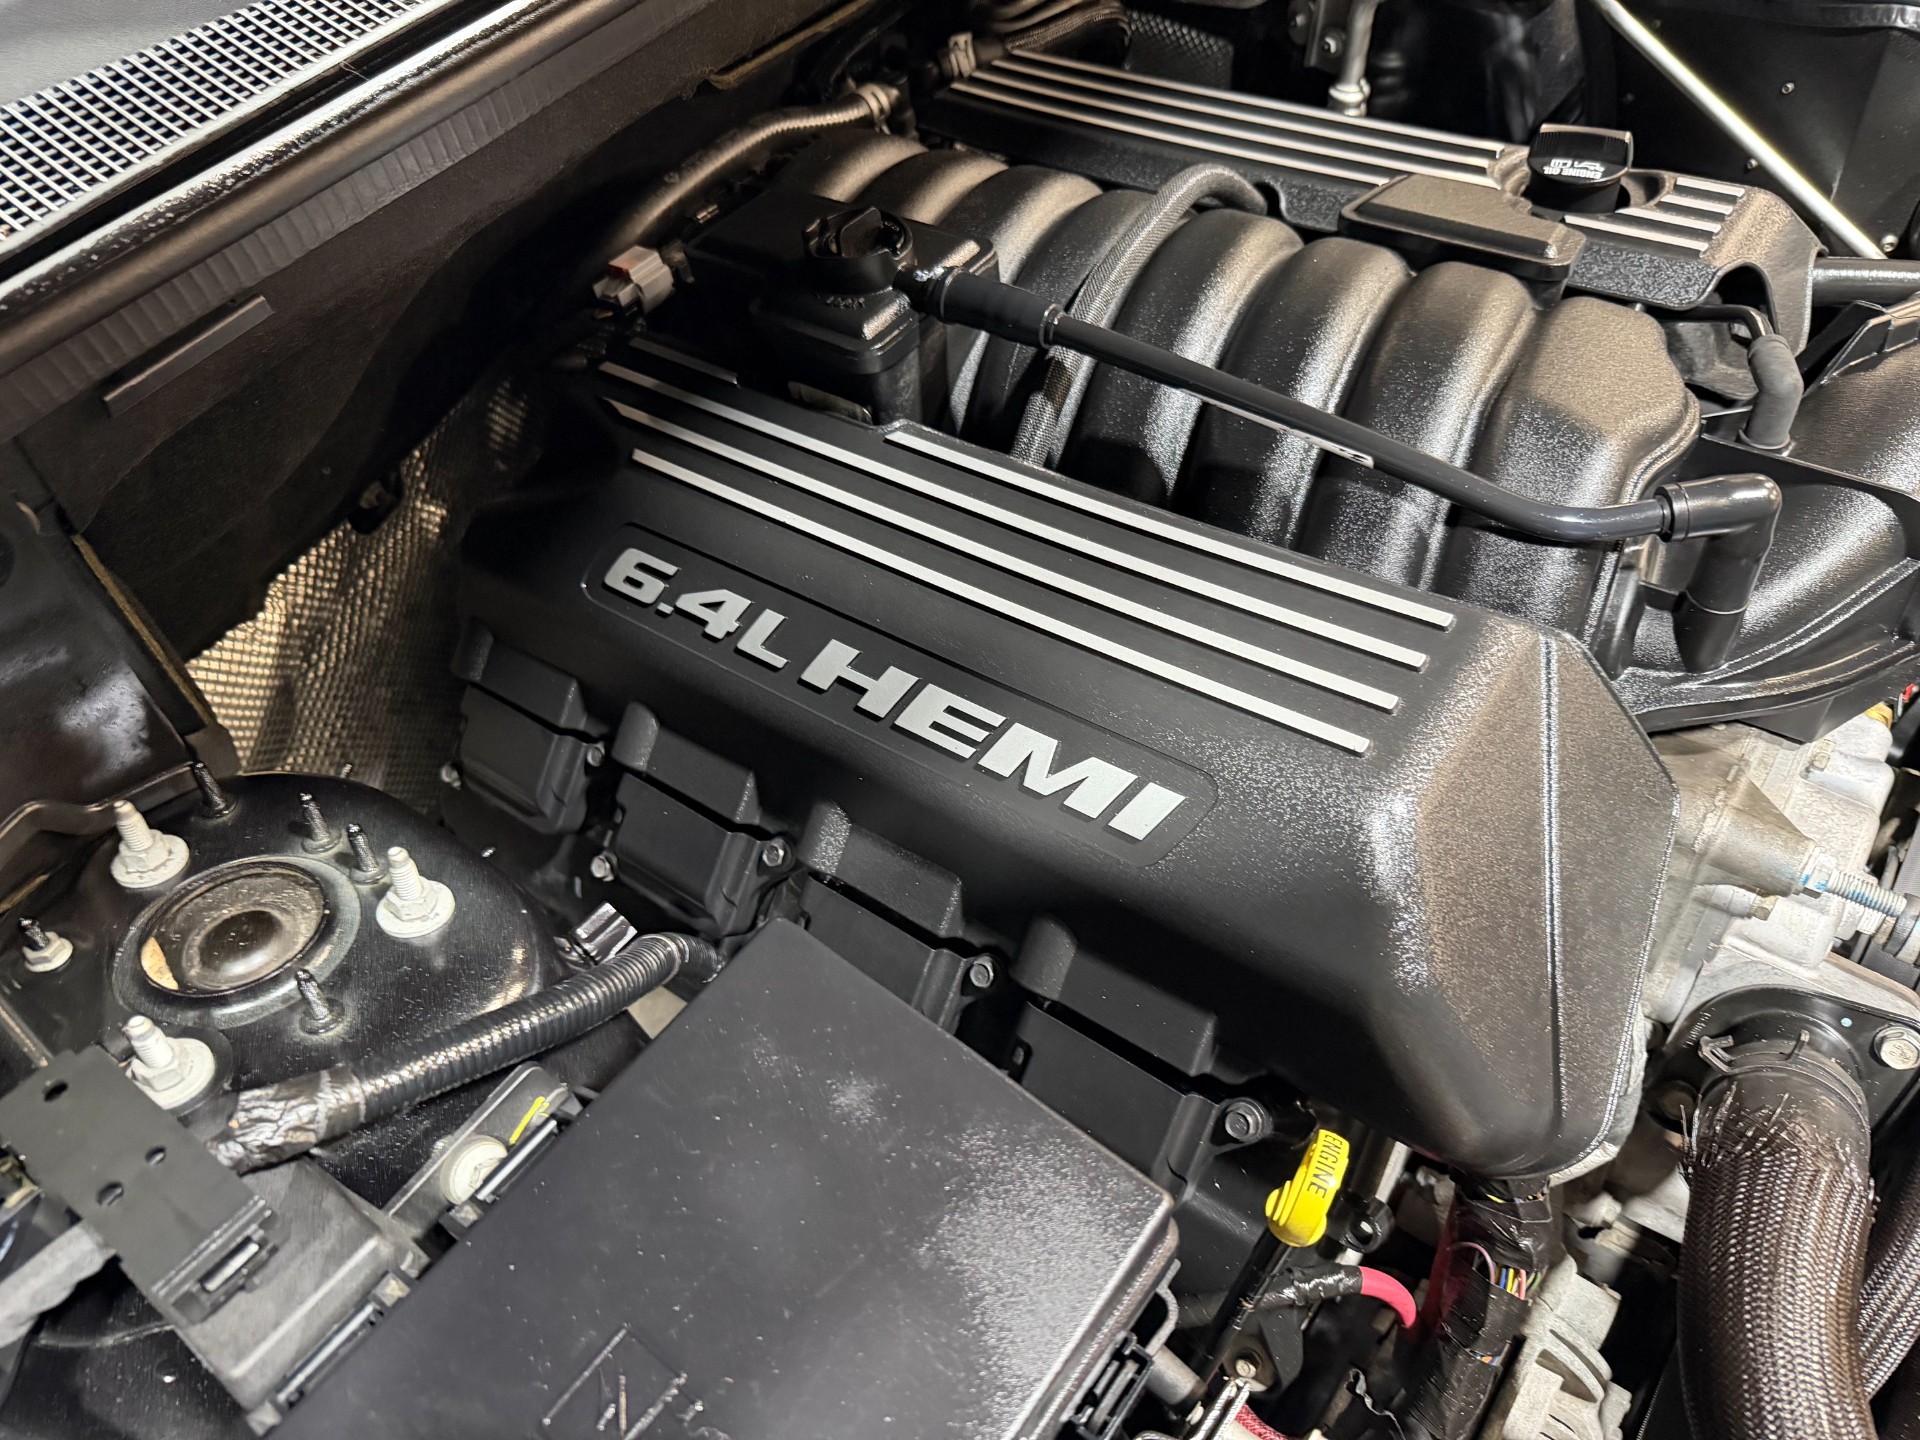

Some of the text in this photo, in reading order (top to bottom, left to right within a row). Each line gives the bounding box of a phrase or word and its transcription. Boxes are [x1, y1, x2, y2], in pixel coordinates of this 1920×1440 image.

[1543, 166, 1561, 175] OIL
[603, 547, 1187, 841] 6.4L HEMI
[1306, 1134, 1343, 1199] ENGINE
